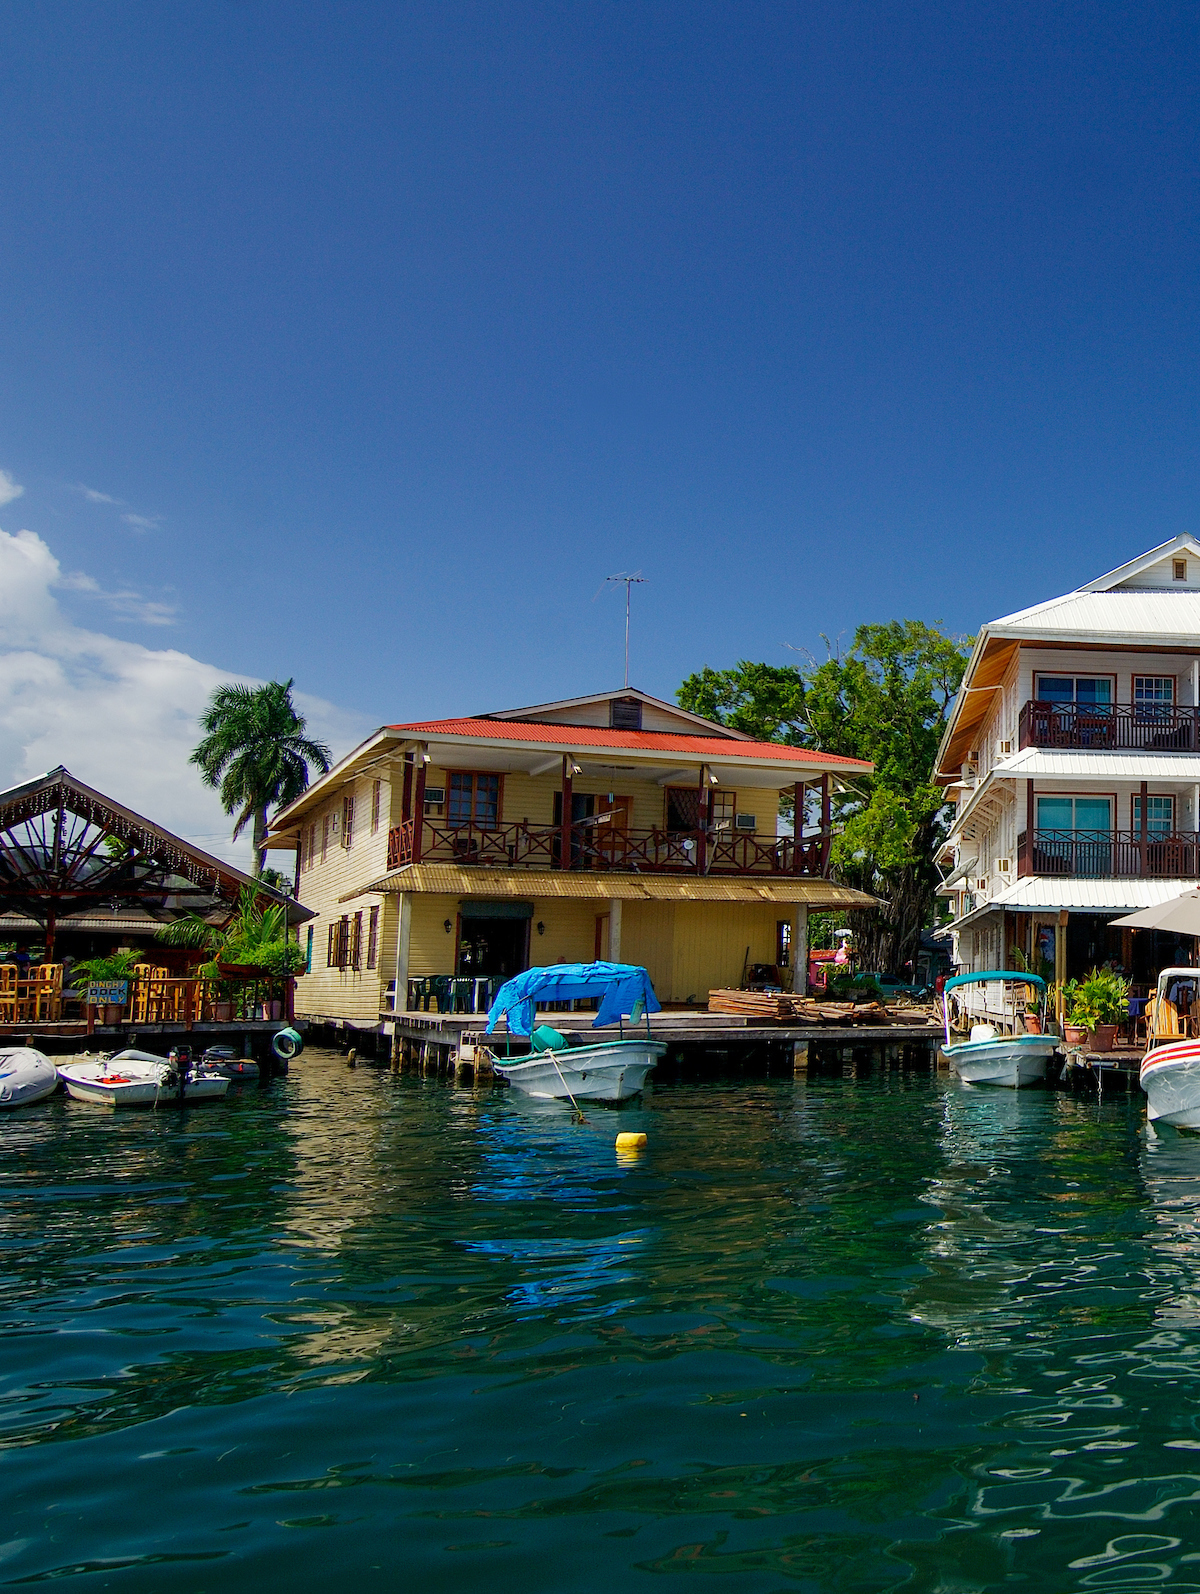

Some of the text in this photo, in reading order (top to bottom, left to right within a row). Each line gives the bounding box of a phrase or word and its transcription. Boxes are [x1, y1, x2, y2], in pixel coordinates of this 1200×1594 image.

[90, 980, 125, 988] DINGHY
[90, 988, 126, 996] DOCK
[90, 996, 124, 1004] ONLY
